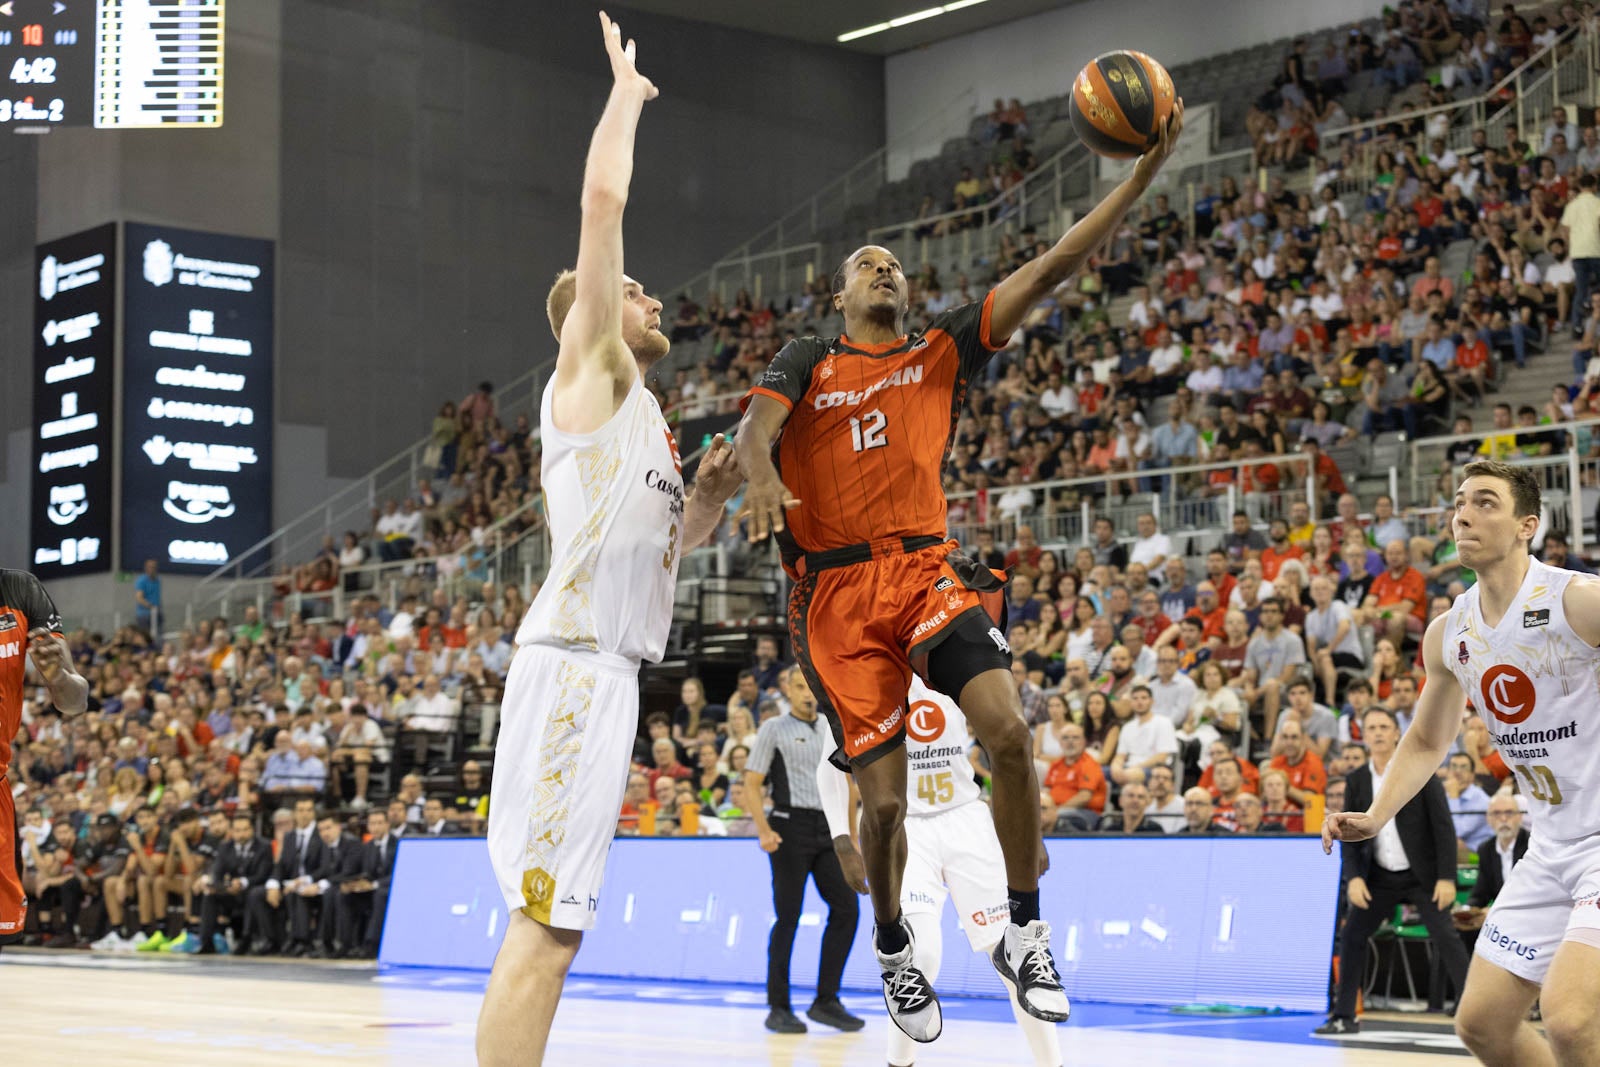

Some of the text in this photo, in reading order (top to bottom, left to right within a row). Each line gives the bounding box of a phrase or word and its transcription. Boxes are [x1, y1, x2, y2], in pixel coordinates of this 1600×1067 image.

[21, 23, 44, 46] 10
[48, 98, 64, 121] 2
[849, 408, 889, 452] 12
[937, 578, 953, 589] acb
[854, 731, 875, 747] vive
[1488, 720, 1578, 747] sademont
[907, 745, 963, 760] sademon
[912, 760, 951, 771] ZARAGOZA
[917, 771, 954, 806] 45
[986, 902, 1010, 915] Zarag
